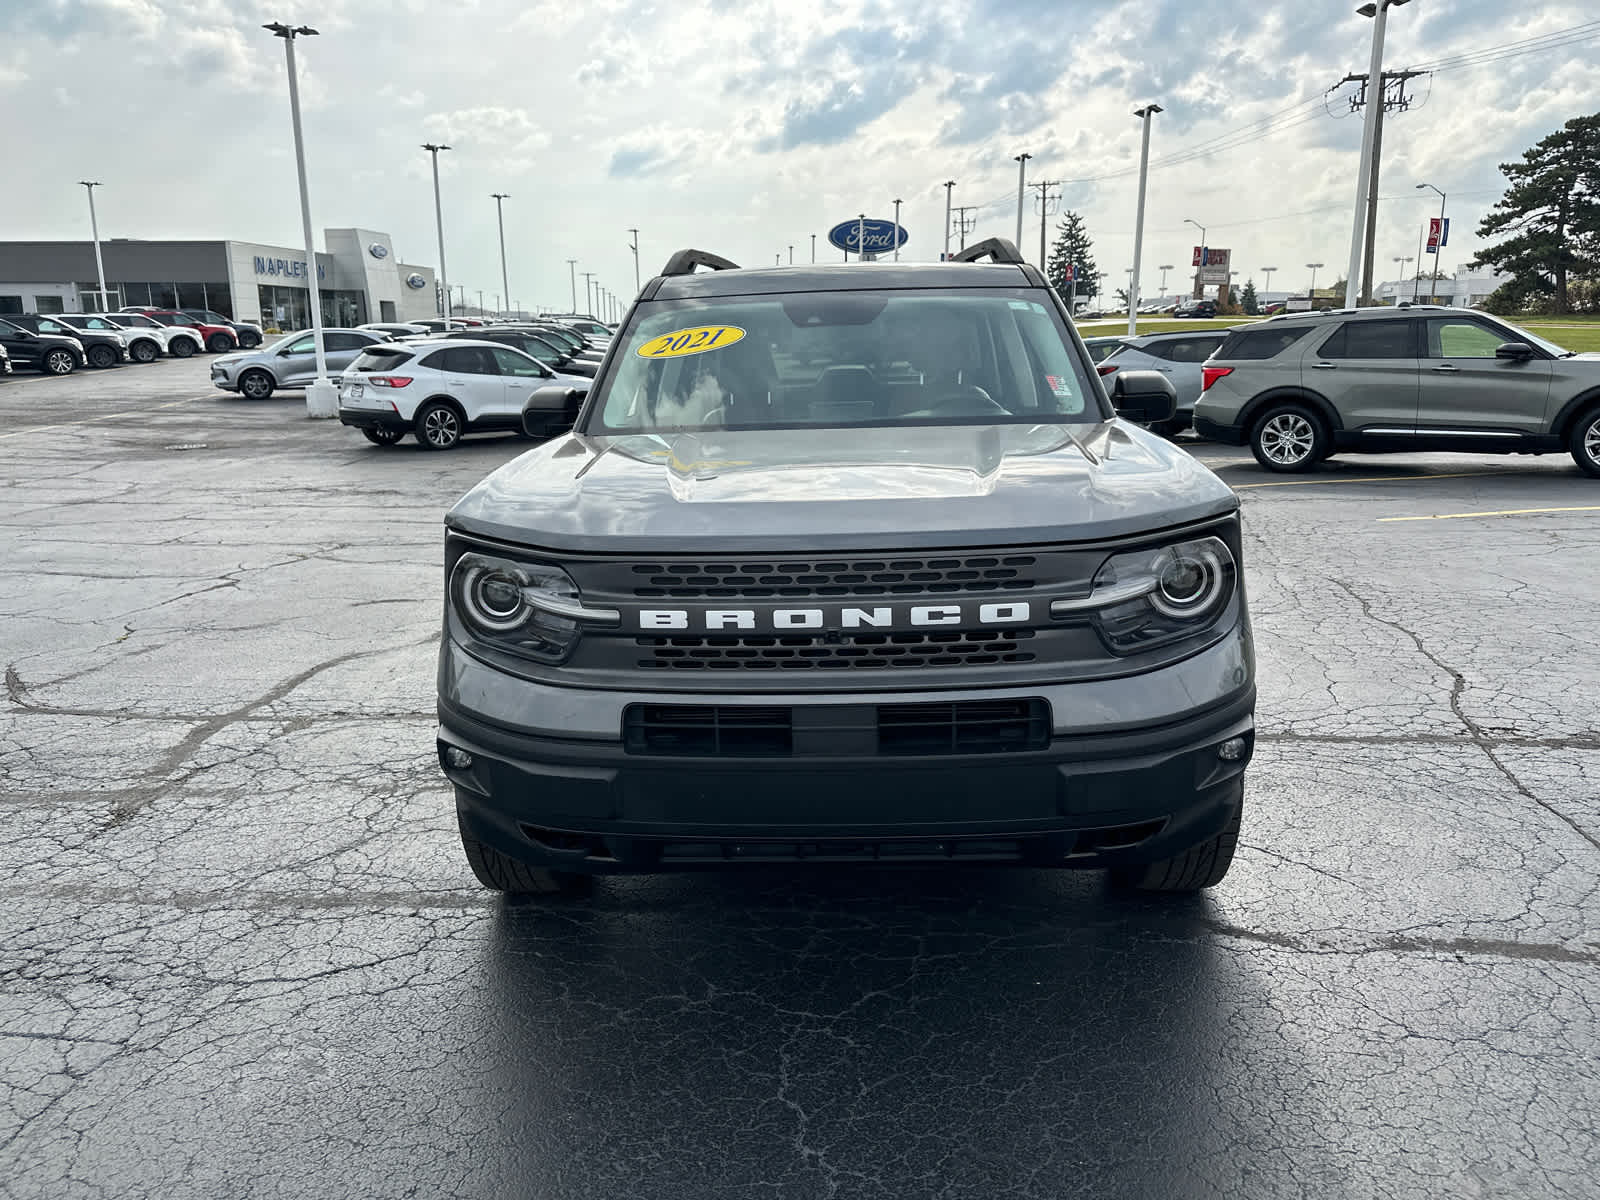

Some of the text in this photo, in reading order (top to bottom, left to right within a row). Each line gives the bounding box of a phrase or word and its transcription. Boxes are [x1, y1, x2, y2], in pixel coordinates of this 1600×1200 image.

[846, 225, 893, 247] Ford
[254, 255, 326, 280] NAPLETN
[651, 328, 726, 356] 2021
[638, 601, 1031, 630] BRONCO
